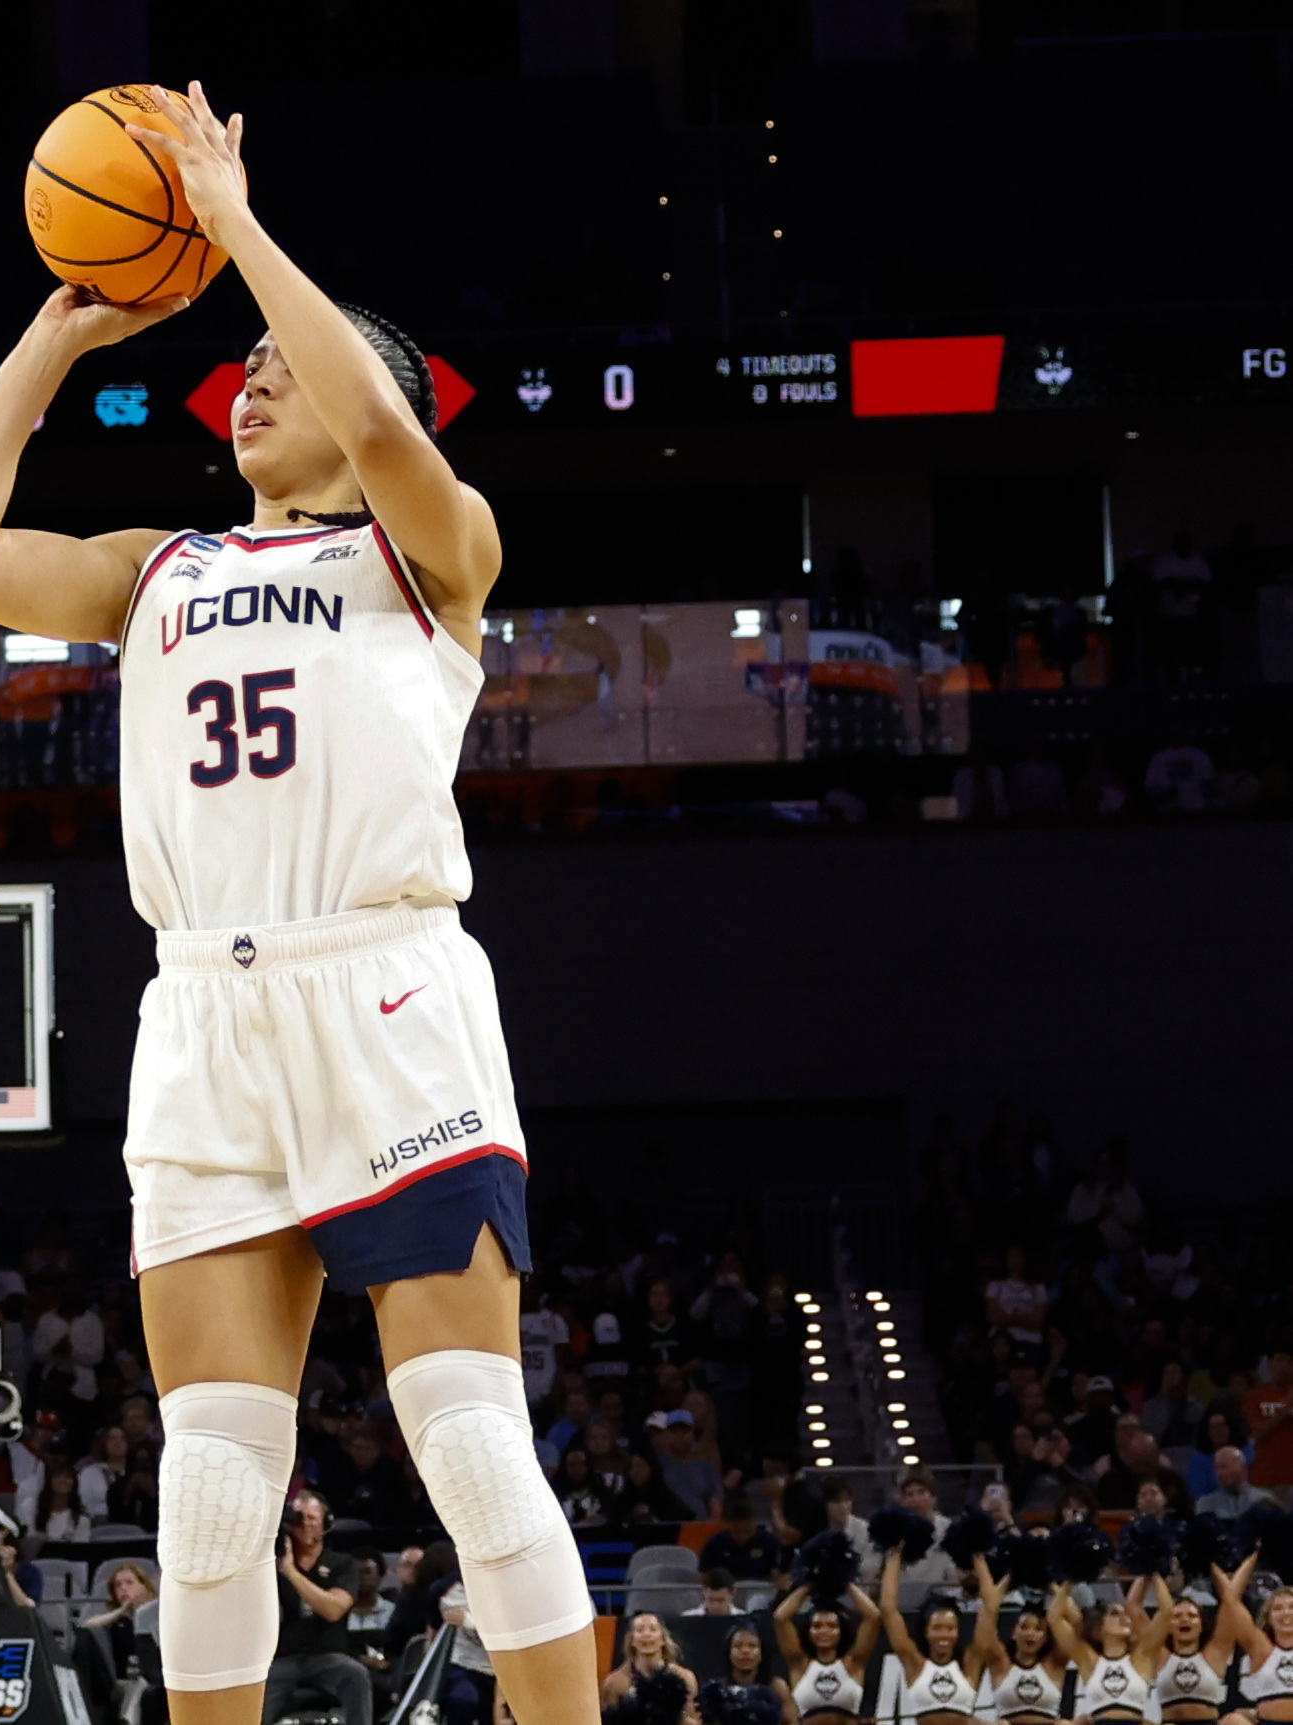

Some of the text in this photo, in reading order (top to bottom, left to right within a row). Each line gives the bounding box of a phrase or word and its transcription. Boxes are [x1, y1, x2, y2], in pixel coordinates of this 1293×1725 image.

[716, 353, 837, 376] 4 TIMEOUTS
[1243, 348, 1287, 378] FG
[603, 364, 636, 410] 0
[752, 381, 838, 404] 0 FOULS
[161, 583, 344, 656] UCONN
[186, 667, 297, 789] 35
[369, 1109, 485, 1181] HUSKIES
